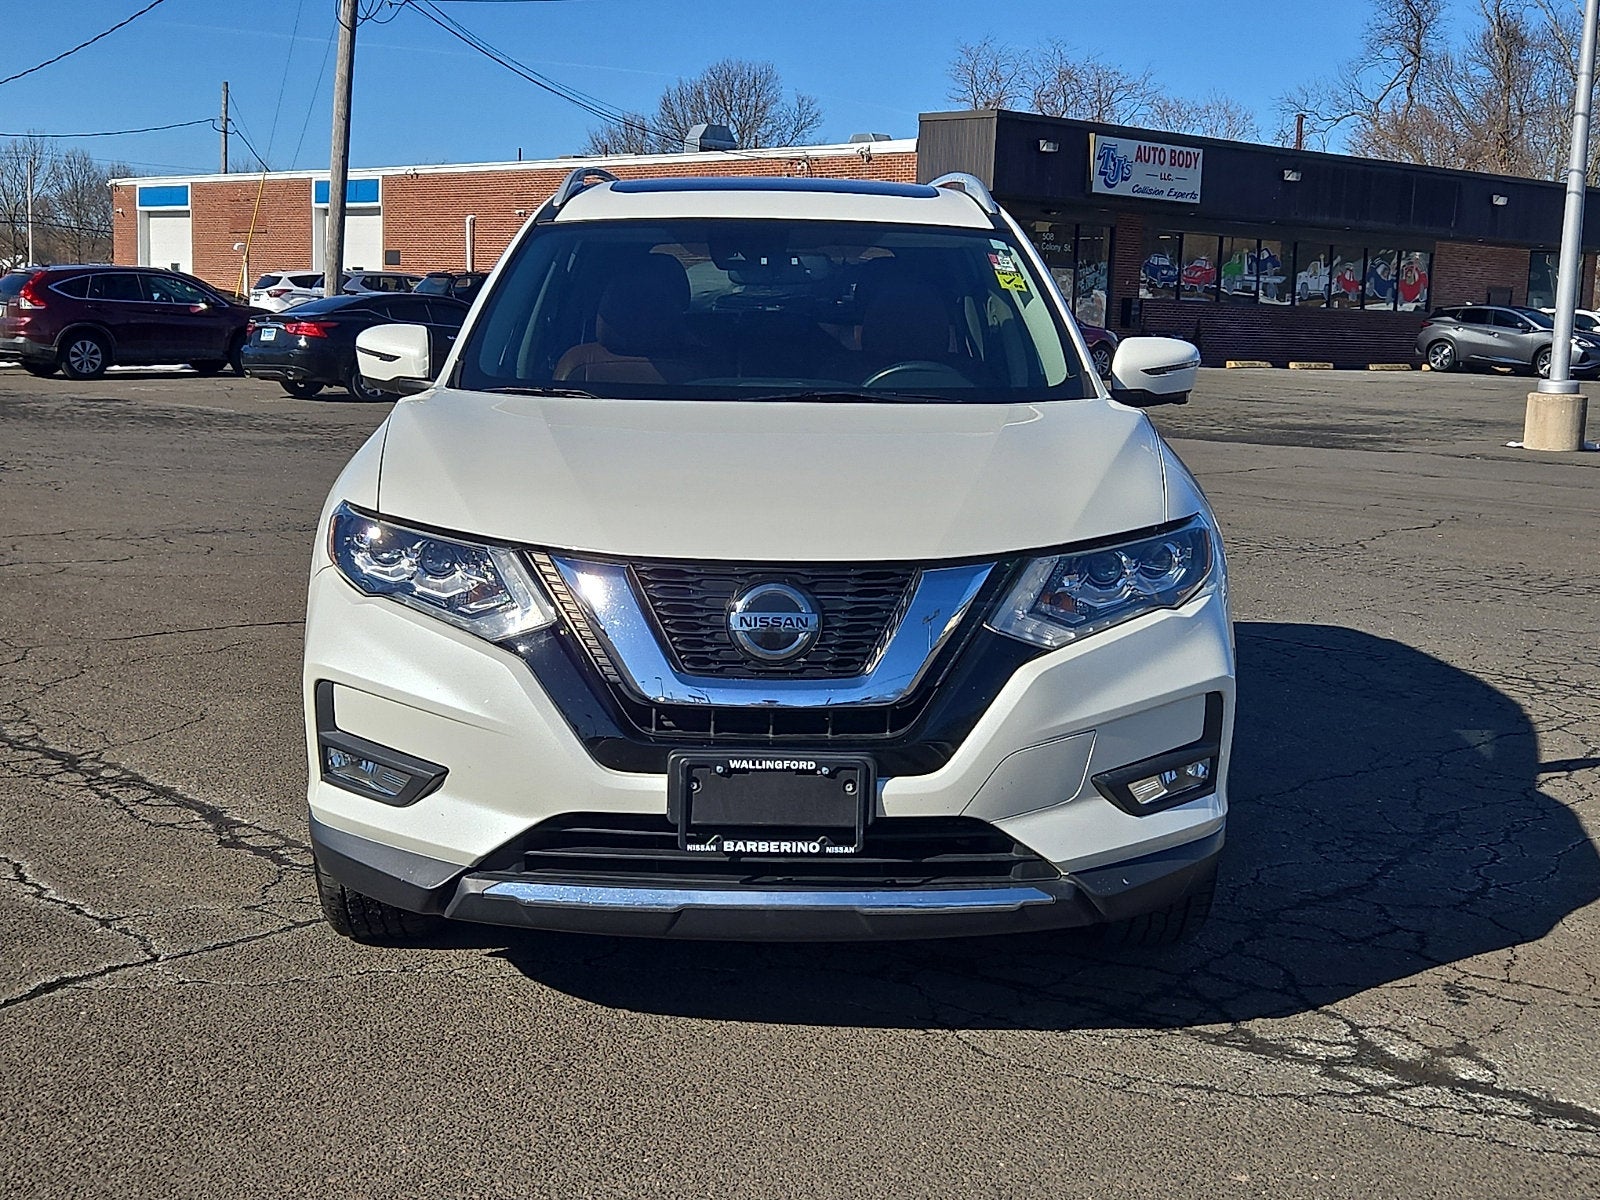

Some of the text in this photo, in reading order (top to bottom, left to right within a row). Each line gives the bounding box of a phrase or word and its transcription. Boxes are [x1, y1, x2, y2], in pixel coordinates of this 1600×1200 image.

[1135, 144, 1201, 170] AUTO BODY
[1131, 183, 1199, 201] Collision Experts
[1042, 232, 1055, 241] 508
[1041, 242, 1062, 253] Colony
[739, 616, 809, 628] NISSAN
[729, 759, 817, 770] WALLINGFORD
[686, 840, 855, 854] NISSAN BARBERINO NISSAN
